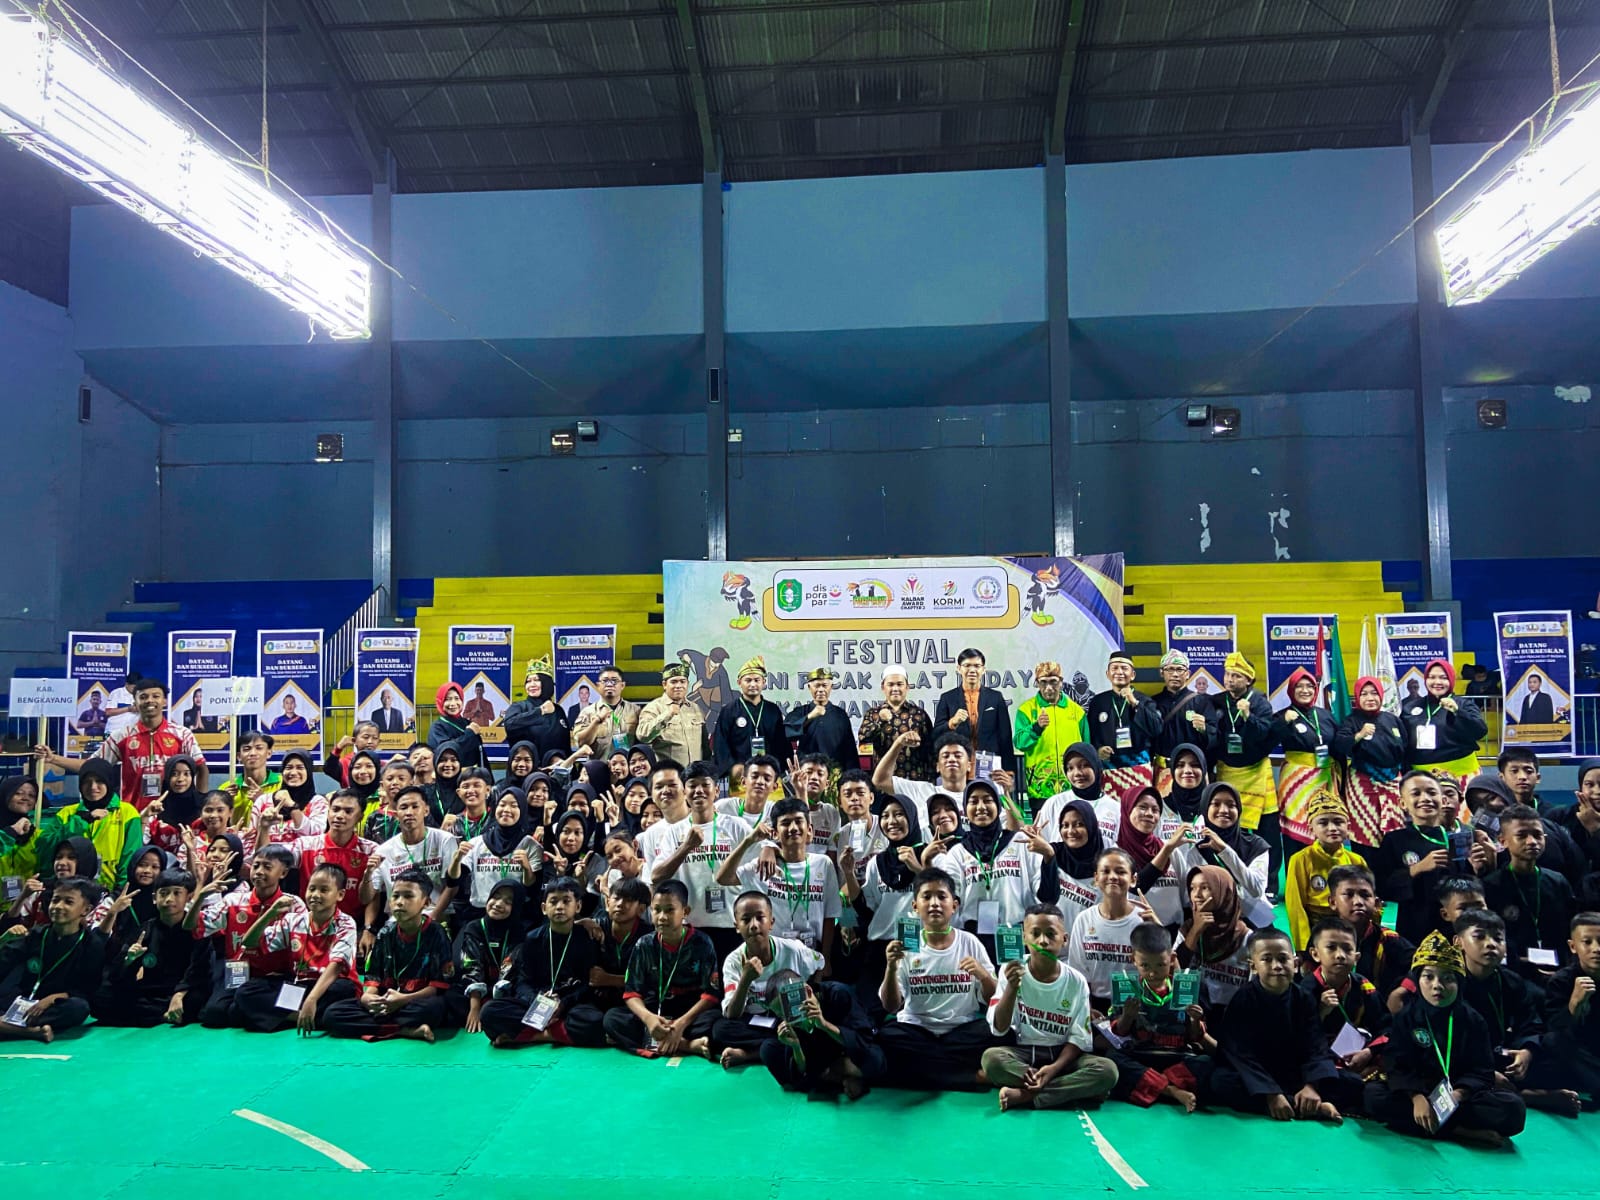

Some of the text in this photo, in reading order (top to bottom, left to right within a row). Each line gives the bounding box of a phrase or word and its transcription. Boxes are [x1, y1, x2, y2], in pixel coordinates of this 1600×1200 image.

[813, 584, 827, 593] dis
[805, 591, 828, 600] pora
[811, 599, 827, 607] par
[827, 638, 956, 664] FESTIVAL
[996, 860, 1020, 868] KORMI
[768, 889, 786, 900] KOTA
